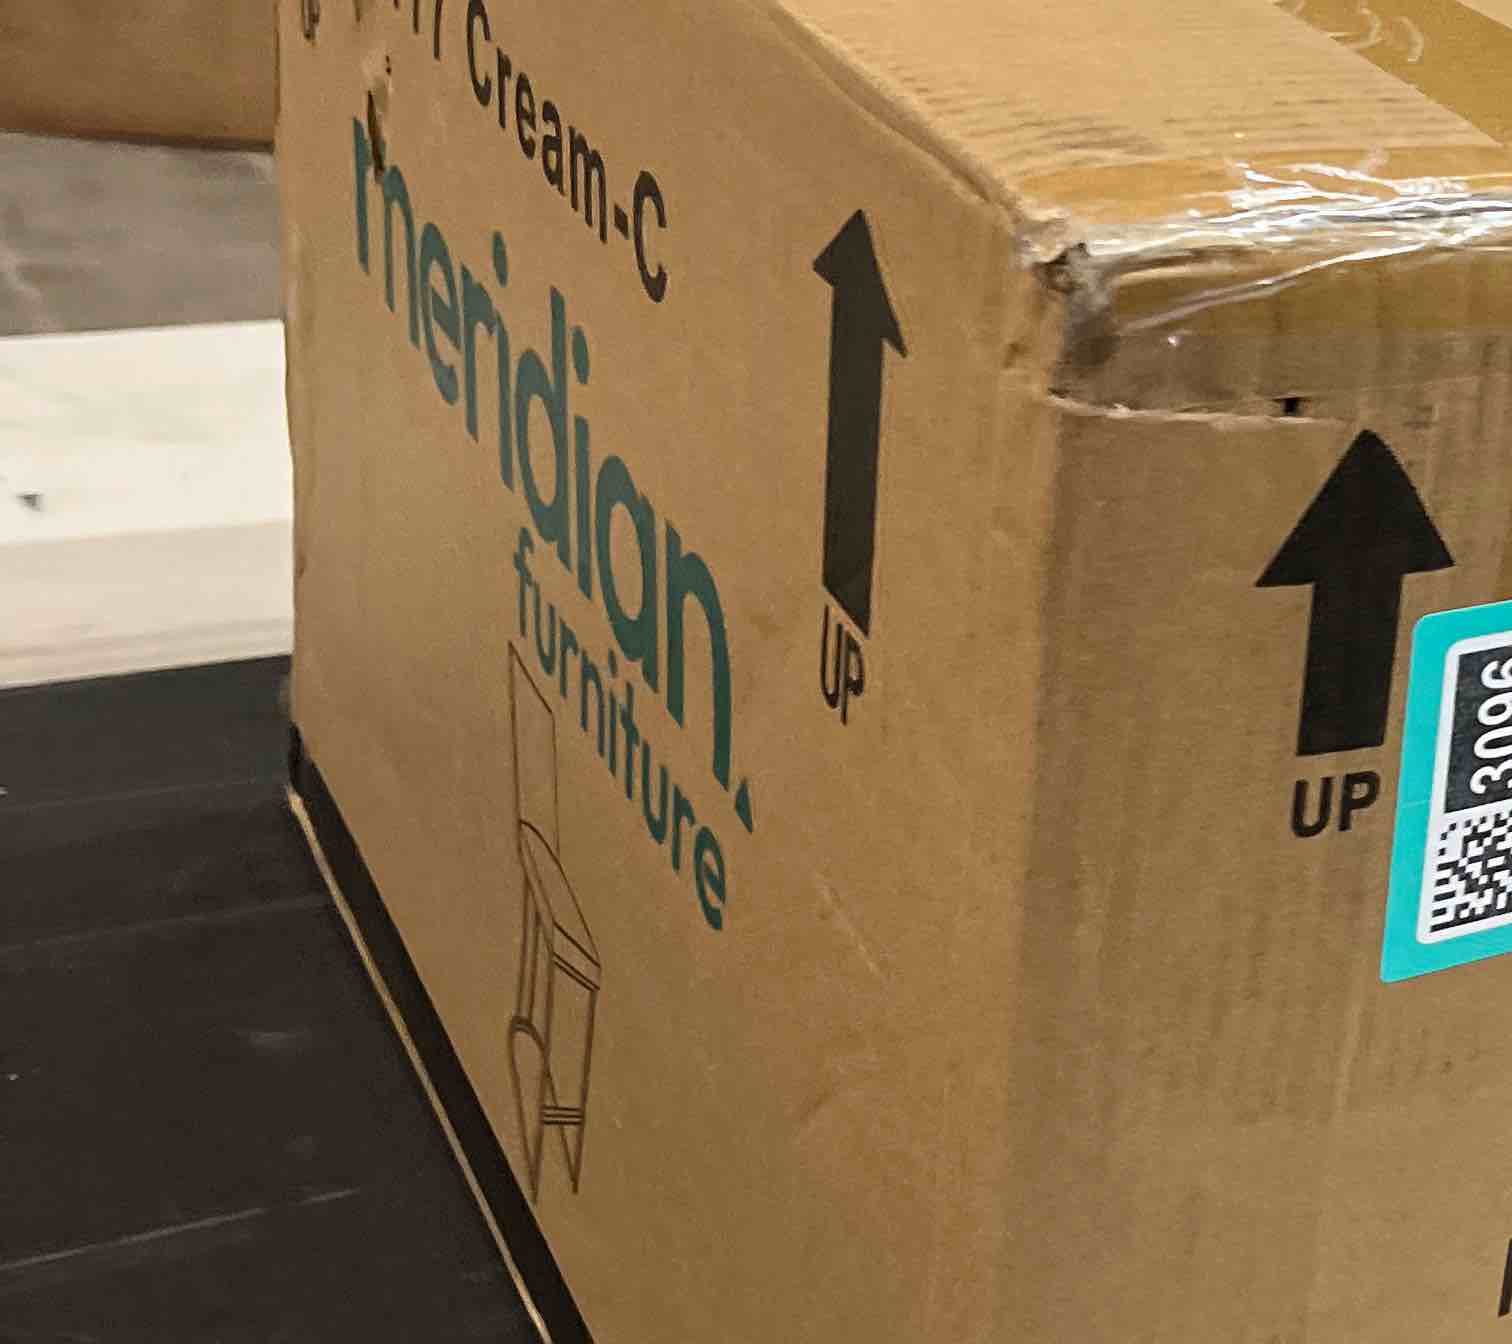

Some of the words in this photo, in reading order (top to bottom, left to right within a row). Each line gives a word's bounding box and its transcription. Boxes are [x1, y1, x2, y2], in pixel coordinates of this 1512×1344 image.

[352, 116, 732, 792] meridian
[512, 526, 727, 933] furniture
[820, 604, 866, 725] UP
[1290, 769, 1381, 840] UP
